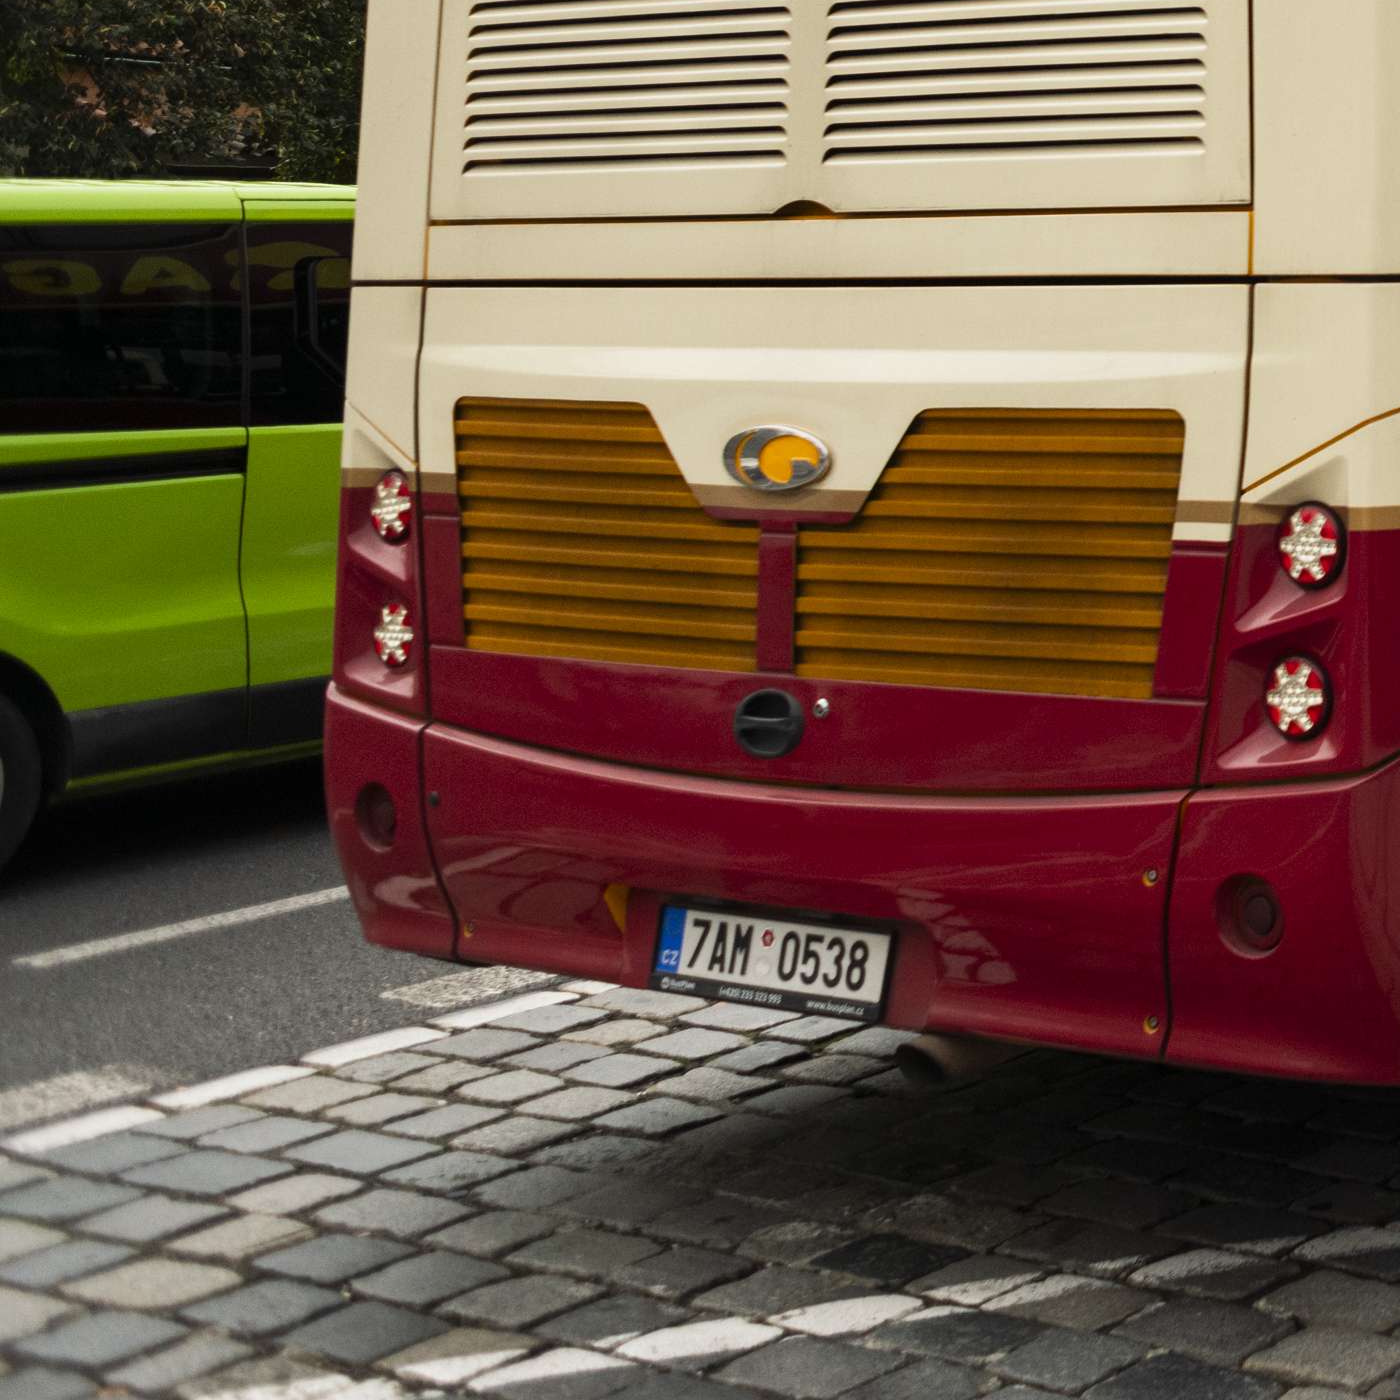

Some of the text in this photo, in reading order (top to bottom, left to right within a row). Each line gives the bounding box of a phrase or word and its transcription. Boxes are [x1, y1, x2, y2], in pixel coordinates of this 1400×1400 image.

[661, 949, 678, 965] CZ
[687, 917, 869, 991] 7AM 0538
